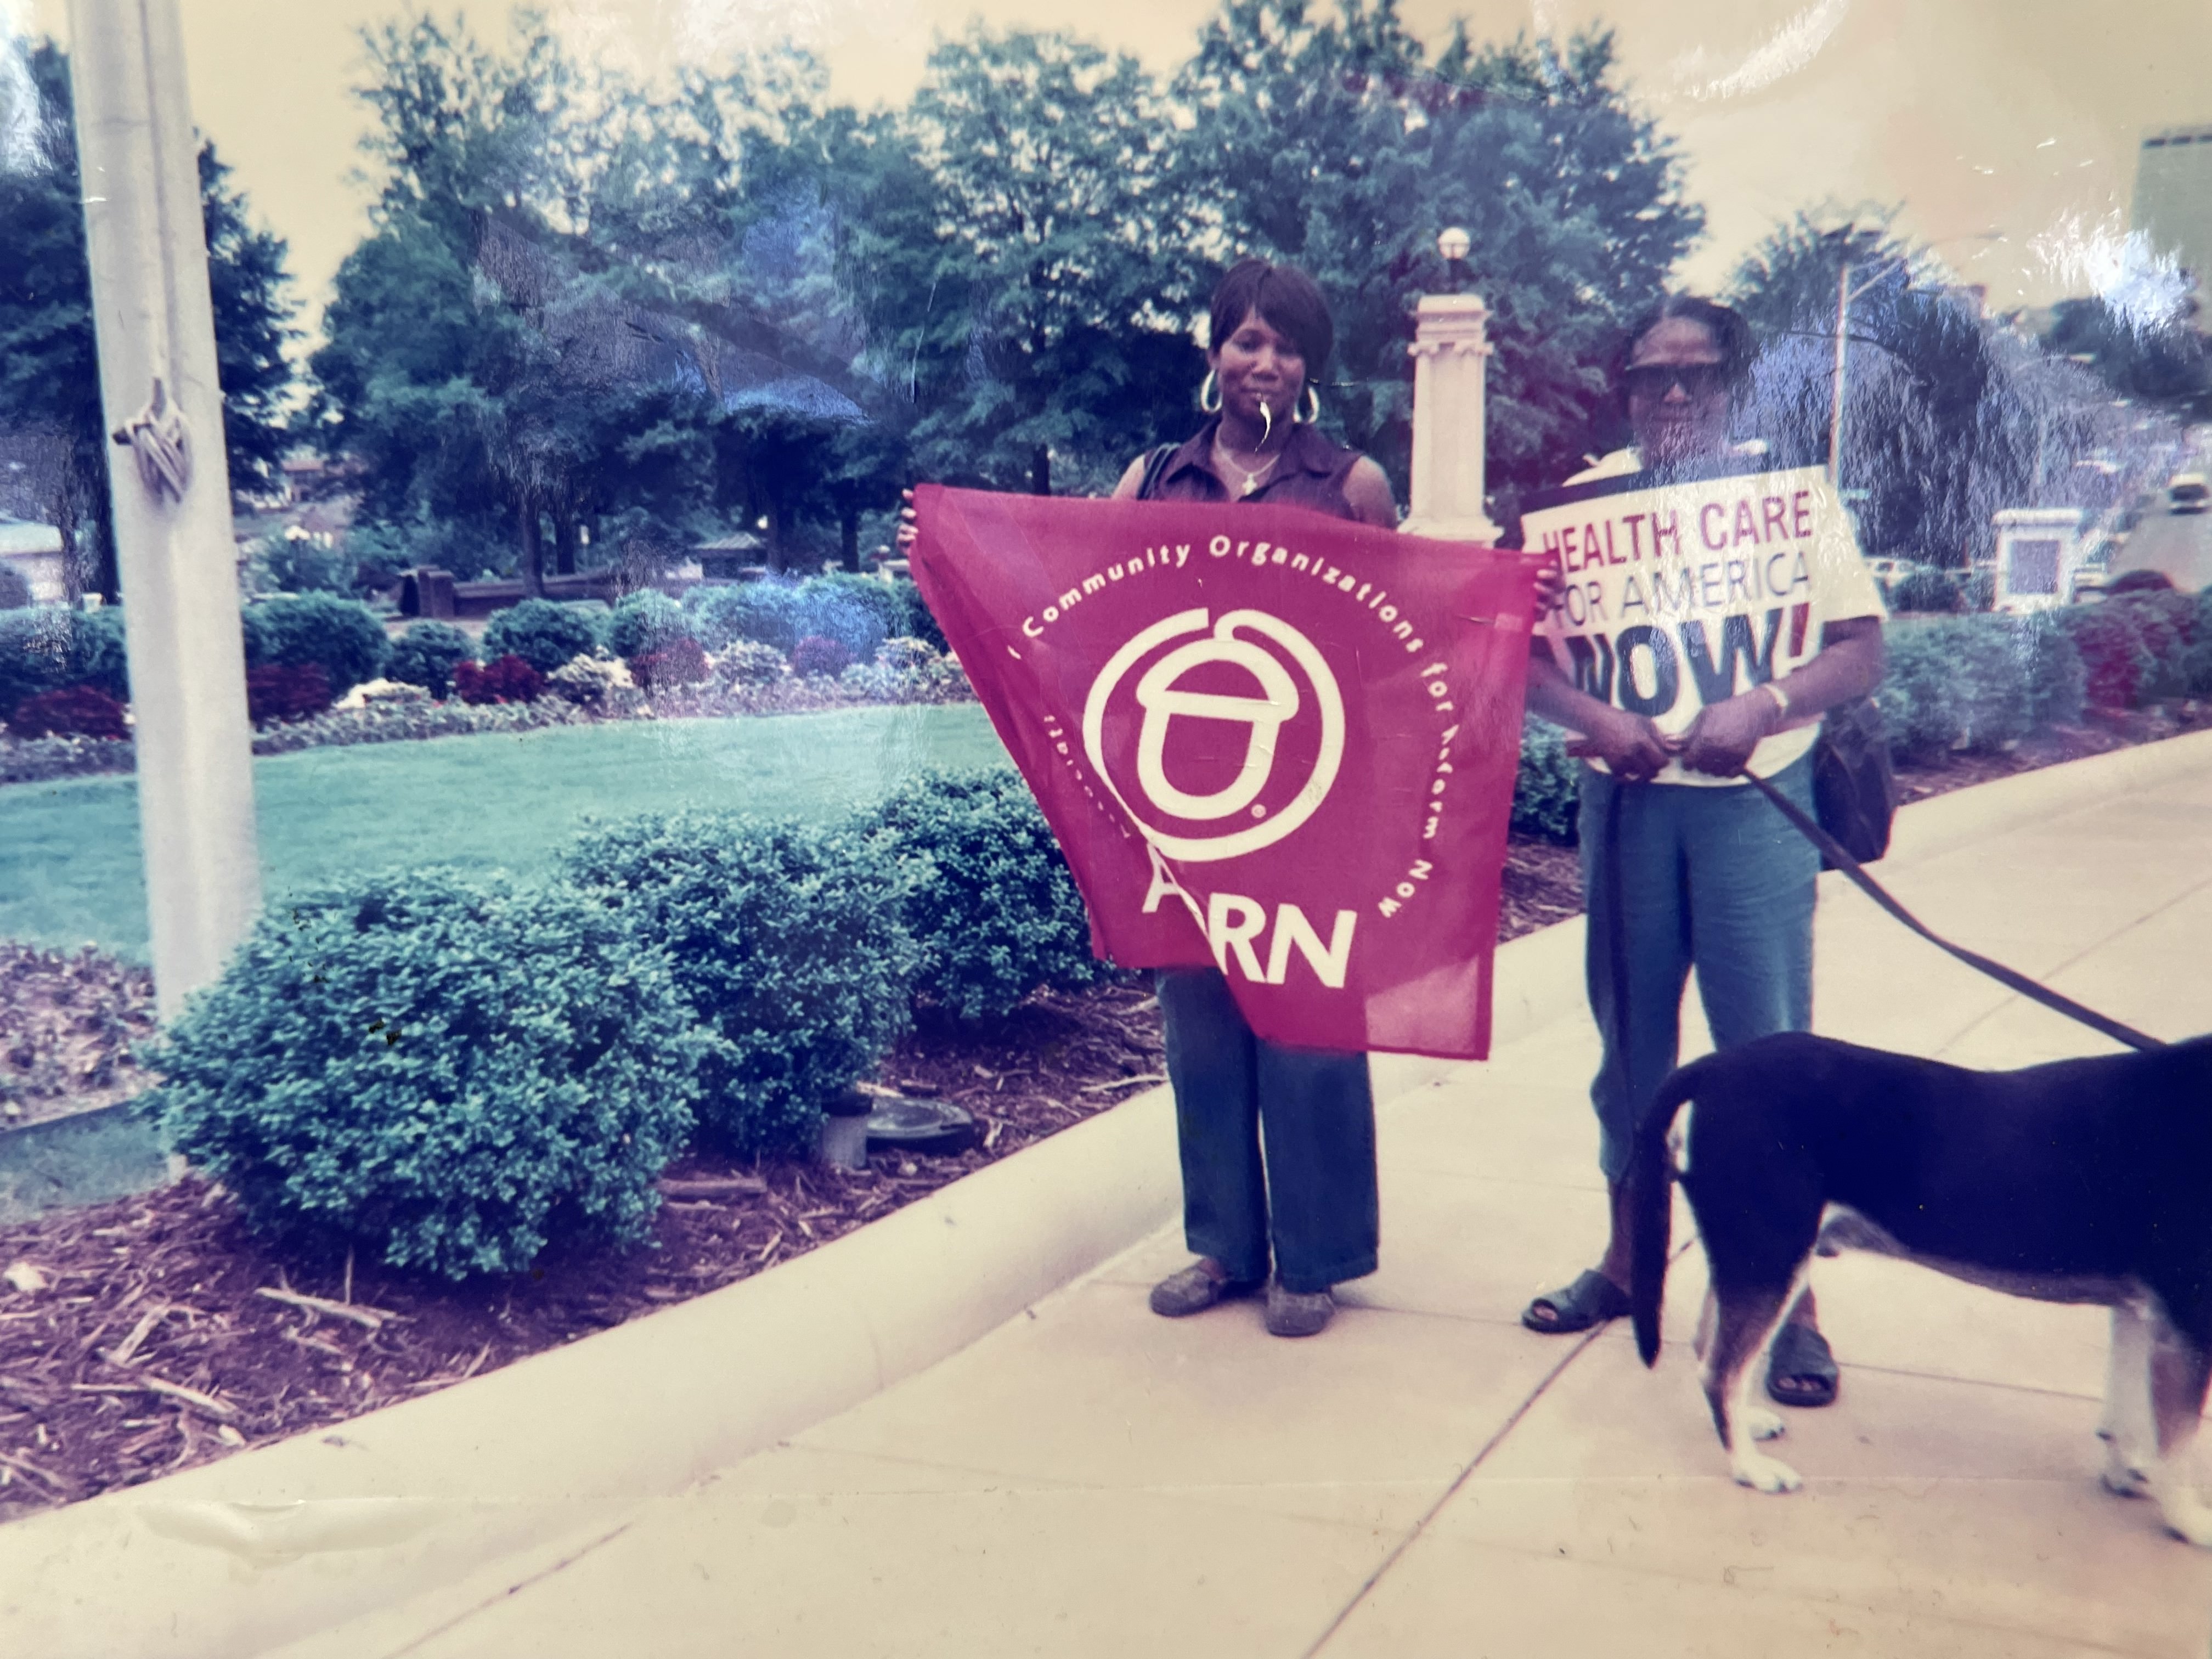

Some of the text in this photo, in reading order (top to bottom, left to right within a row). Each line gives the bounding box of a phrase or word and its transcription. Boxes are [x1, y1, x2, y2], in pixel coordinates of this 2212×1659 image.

[1543, 490, 1812, 573] HEALTH CARE
[1022, 543, 1190, 638] Community
[1209, 534, 1424, 653] Organizations
[1620, 551, 1811, 618] AMERICA
[1420, 662, 1455, 711] for
[1378, 859, 1434, 918] Now
